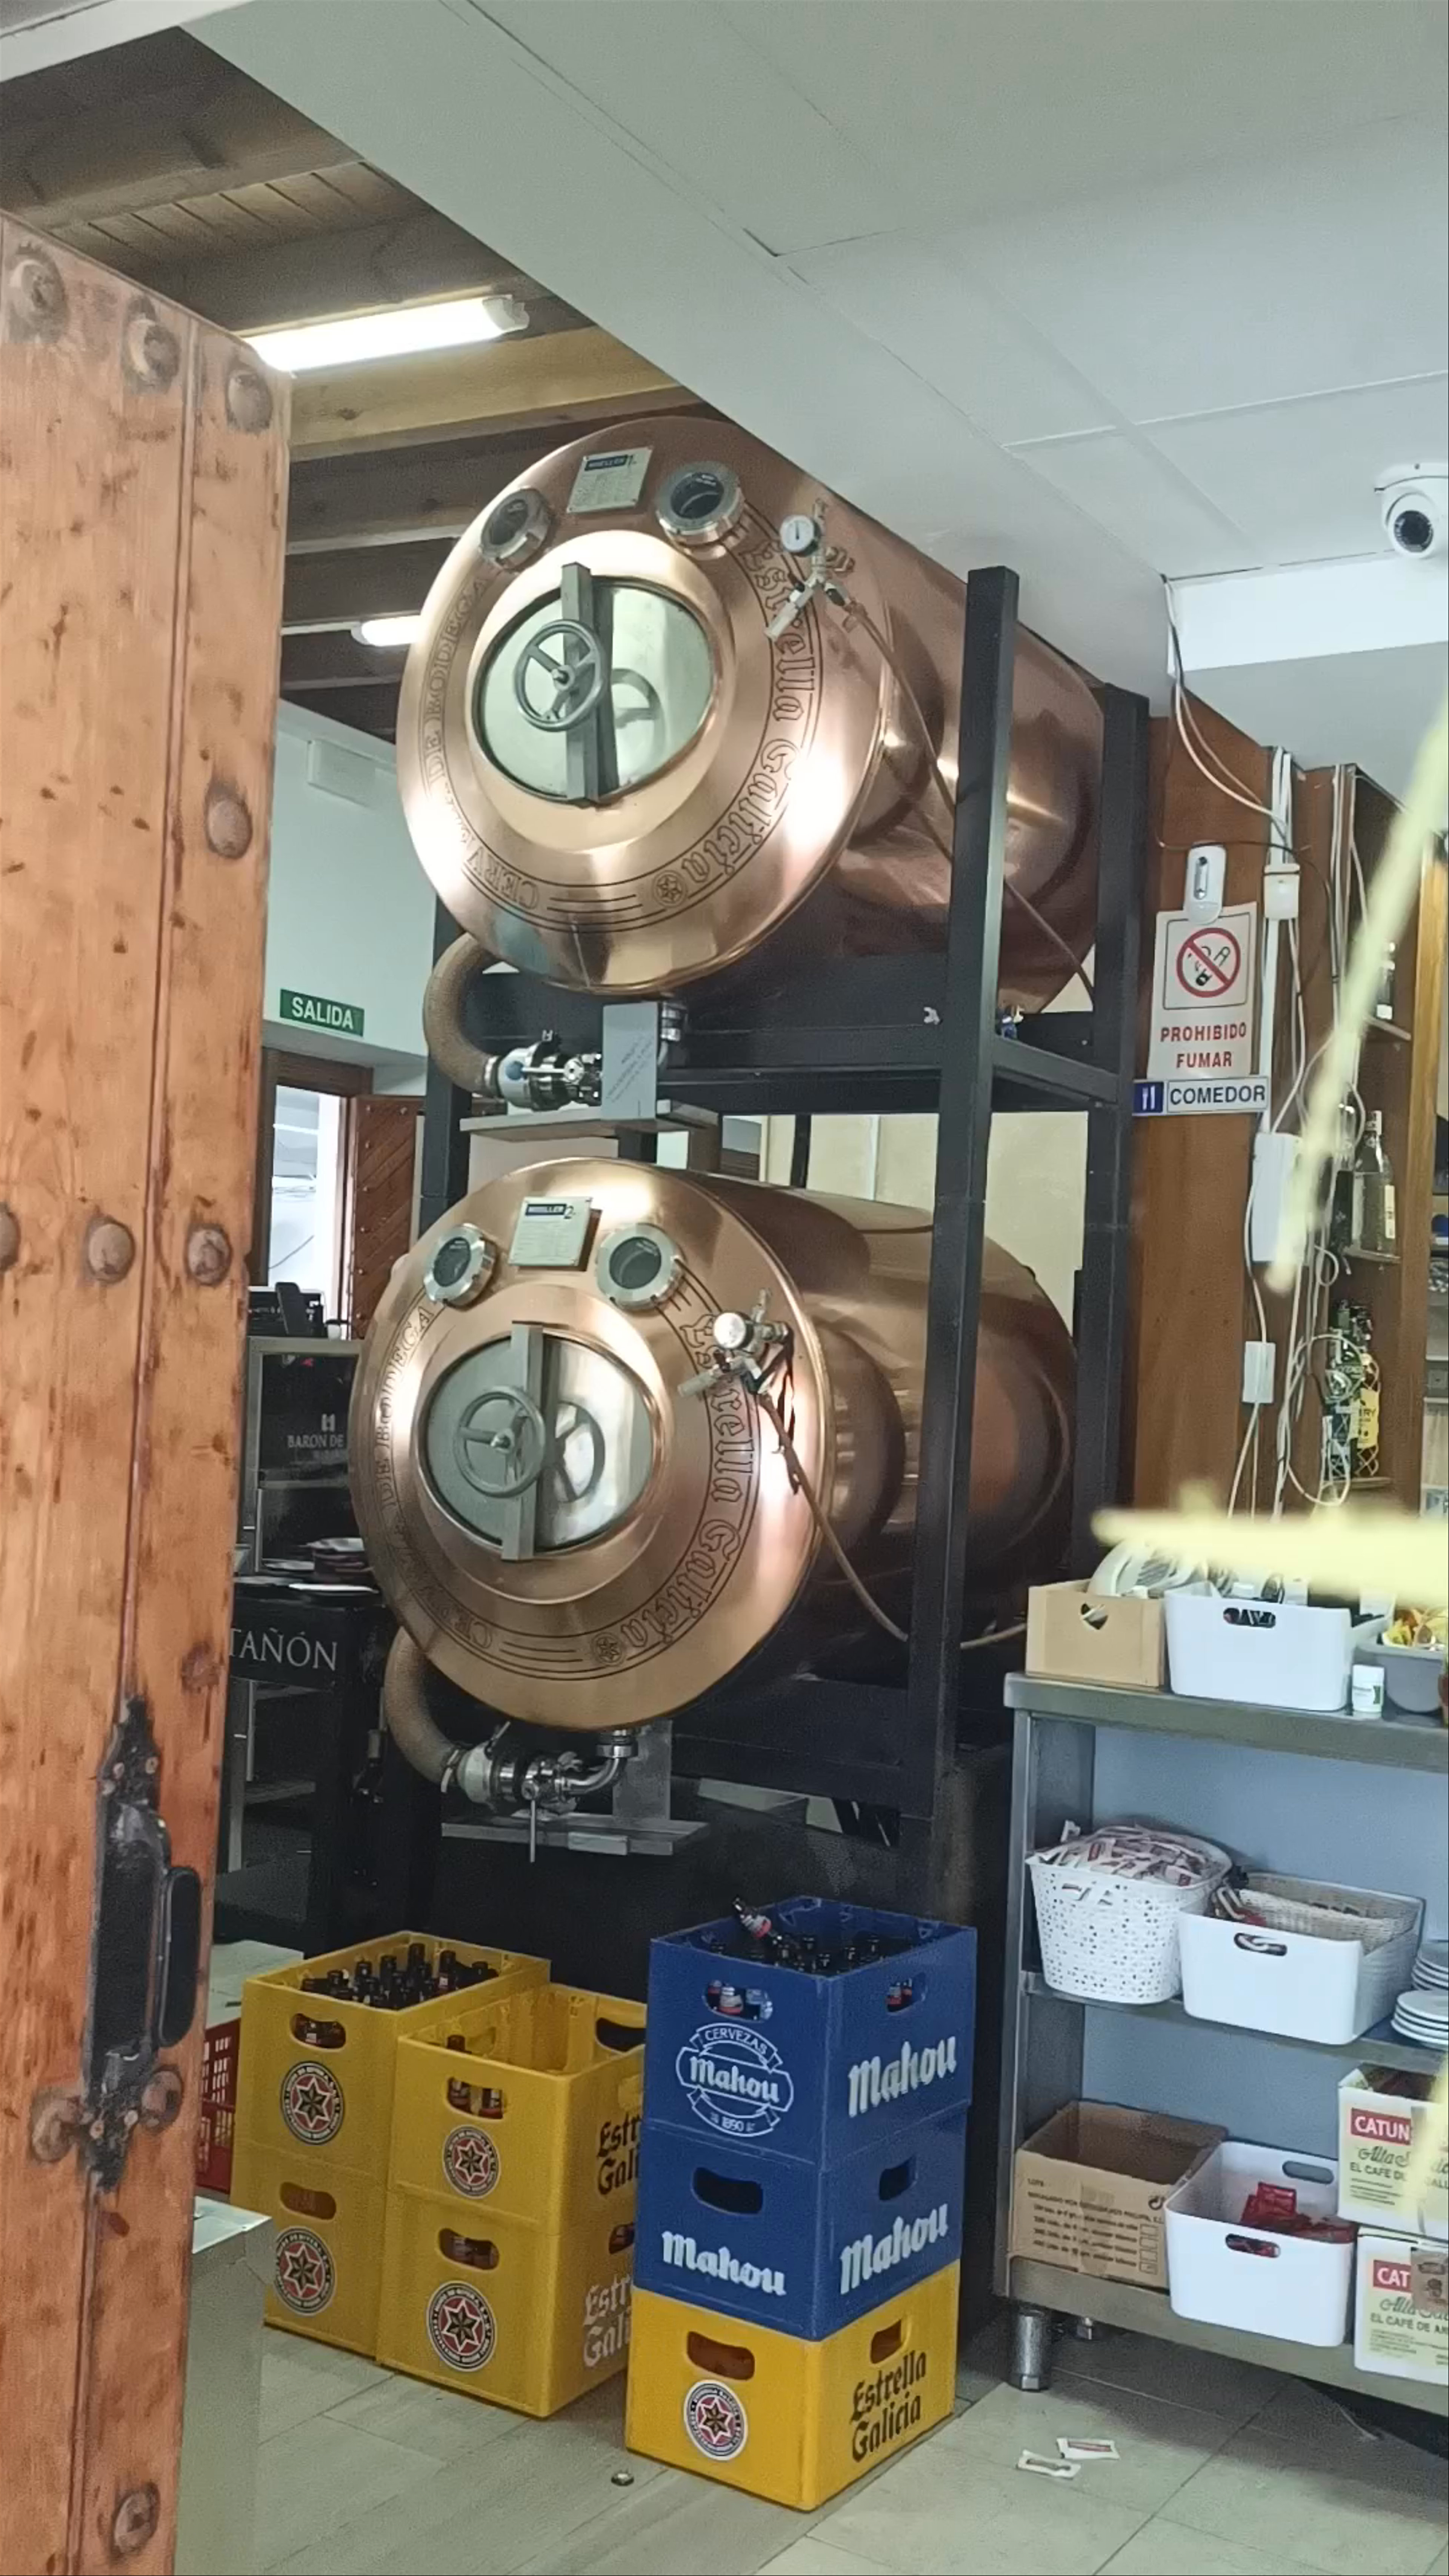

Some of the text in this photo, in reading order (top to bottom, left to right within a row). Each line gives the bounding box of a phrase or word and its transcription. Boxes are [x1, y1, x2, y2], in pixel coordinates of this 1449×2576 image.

[738, 538, 815, 721] Estella
[291, 997, 354, 1030] SALIDA
[1160, 1022, 1246, 1042] PROHIBIDO
[1176, 1052, 1232, 1068] FUMAR
[1170, 1085, 1266, 1105] COMEDOR
[621, 1519, 741, 1647] Galicia
[705, 2027, 768, 2055] CERVEZAS
[689, 2056, 780, 2103] Mahou
[848, 2036, 957, 2118] Mahou
[662, 2230, 787, 2296] Mahou
[840, 2203, 948, 2295] Mahou
[850, 2350, 926, 2425] Estrella
[852, 2391, 921, 2463] Galicia
